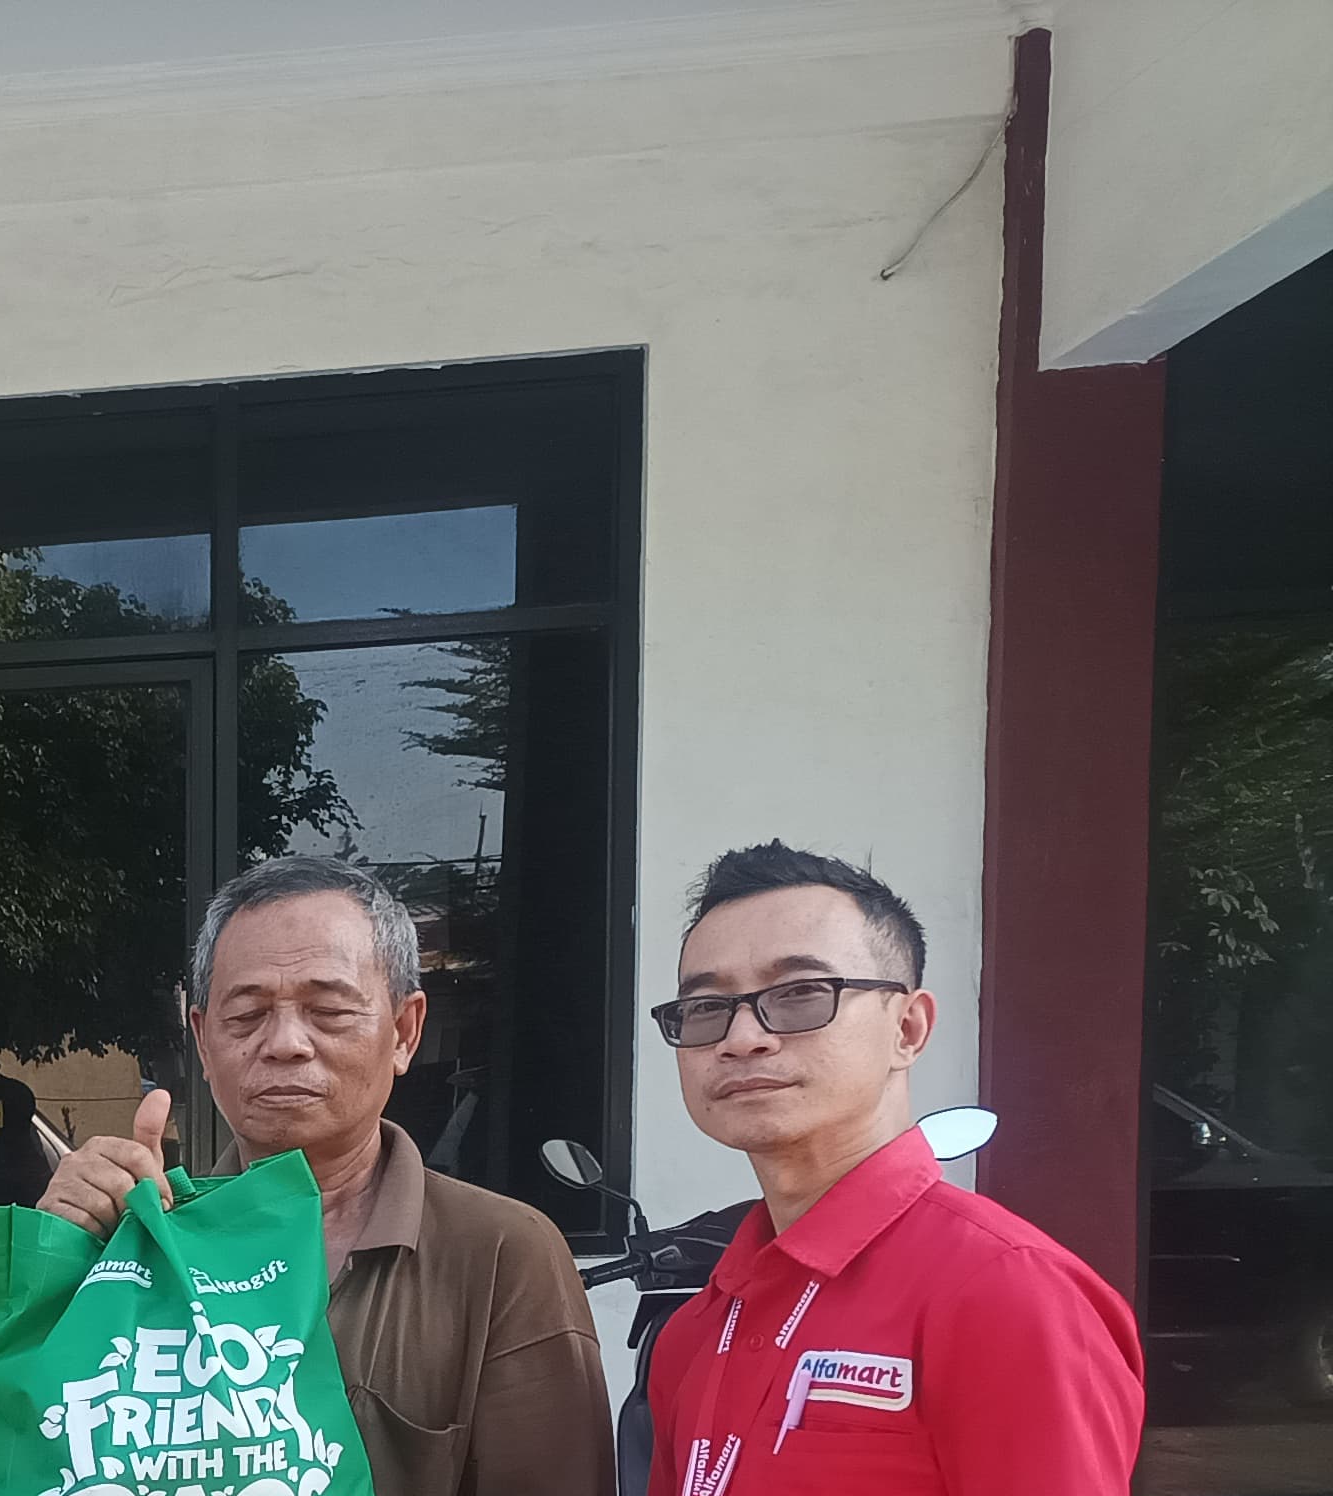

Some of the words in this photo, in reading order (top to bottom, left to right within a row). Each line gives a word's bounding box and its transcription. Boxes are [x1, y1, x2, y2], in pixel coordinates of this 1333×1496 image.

[89, 1260, 153, 1279] amart
[774, 1280, 817, 1348] Alfamart
[132, 1314, 269, 1394] ECO
[801, 1358, 904, 1388] Alfamart
[233, 1439, 288, 1476] THE
